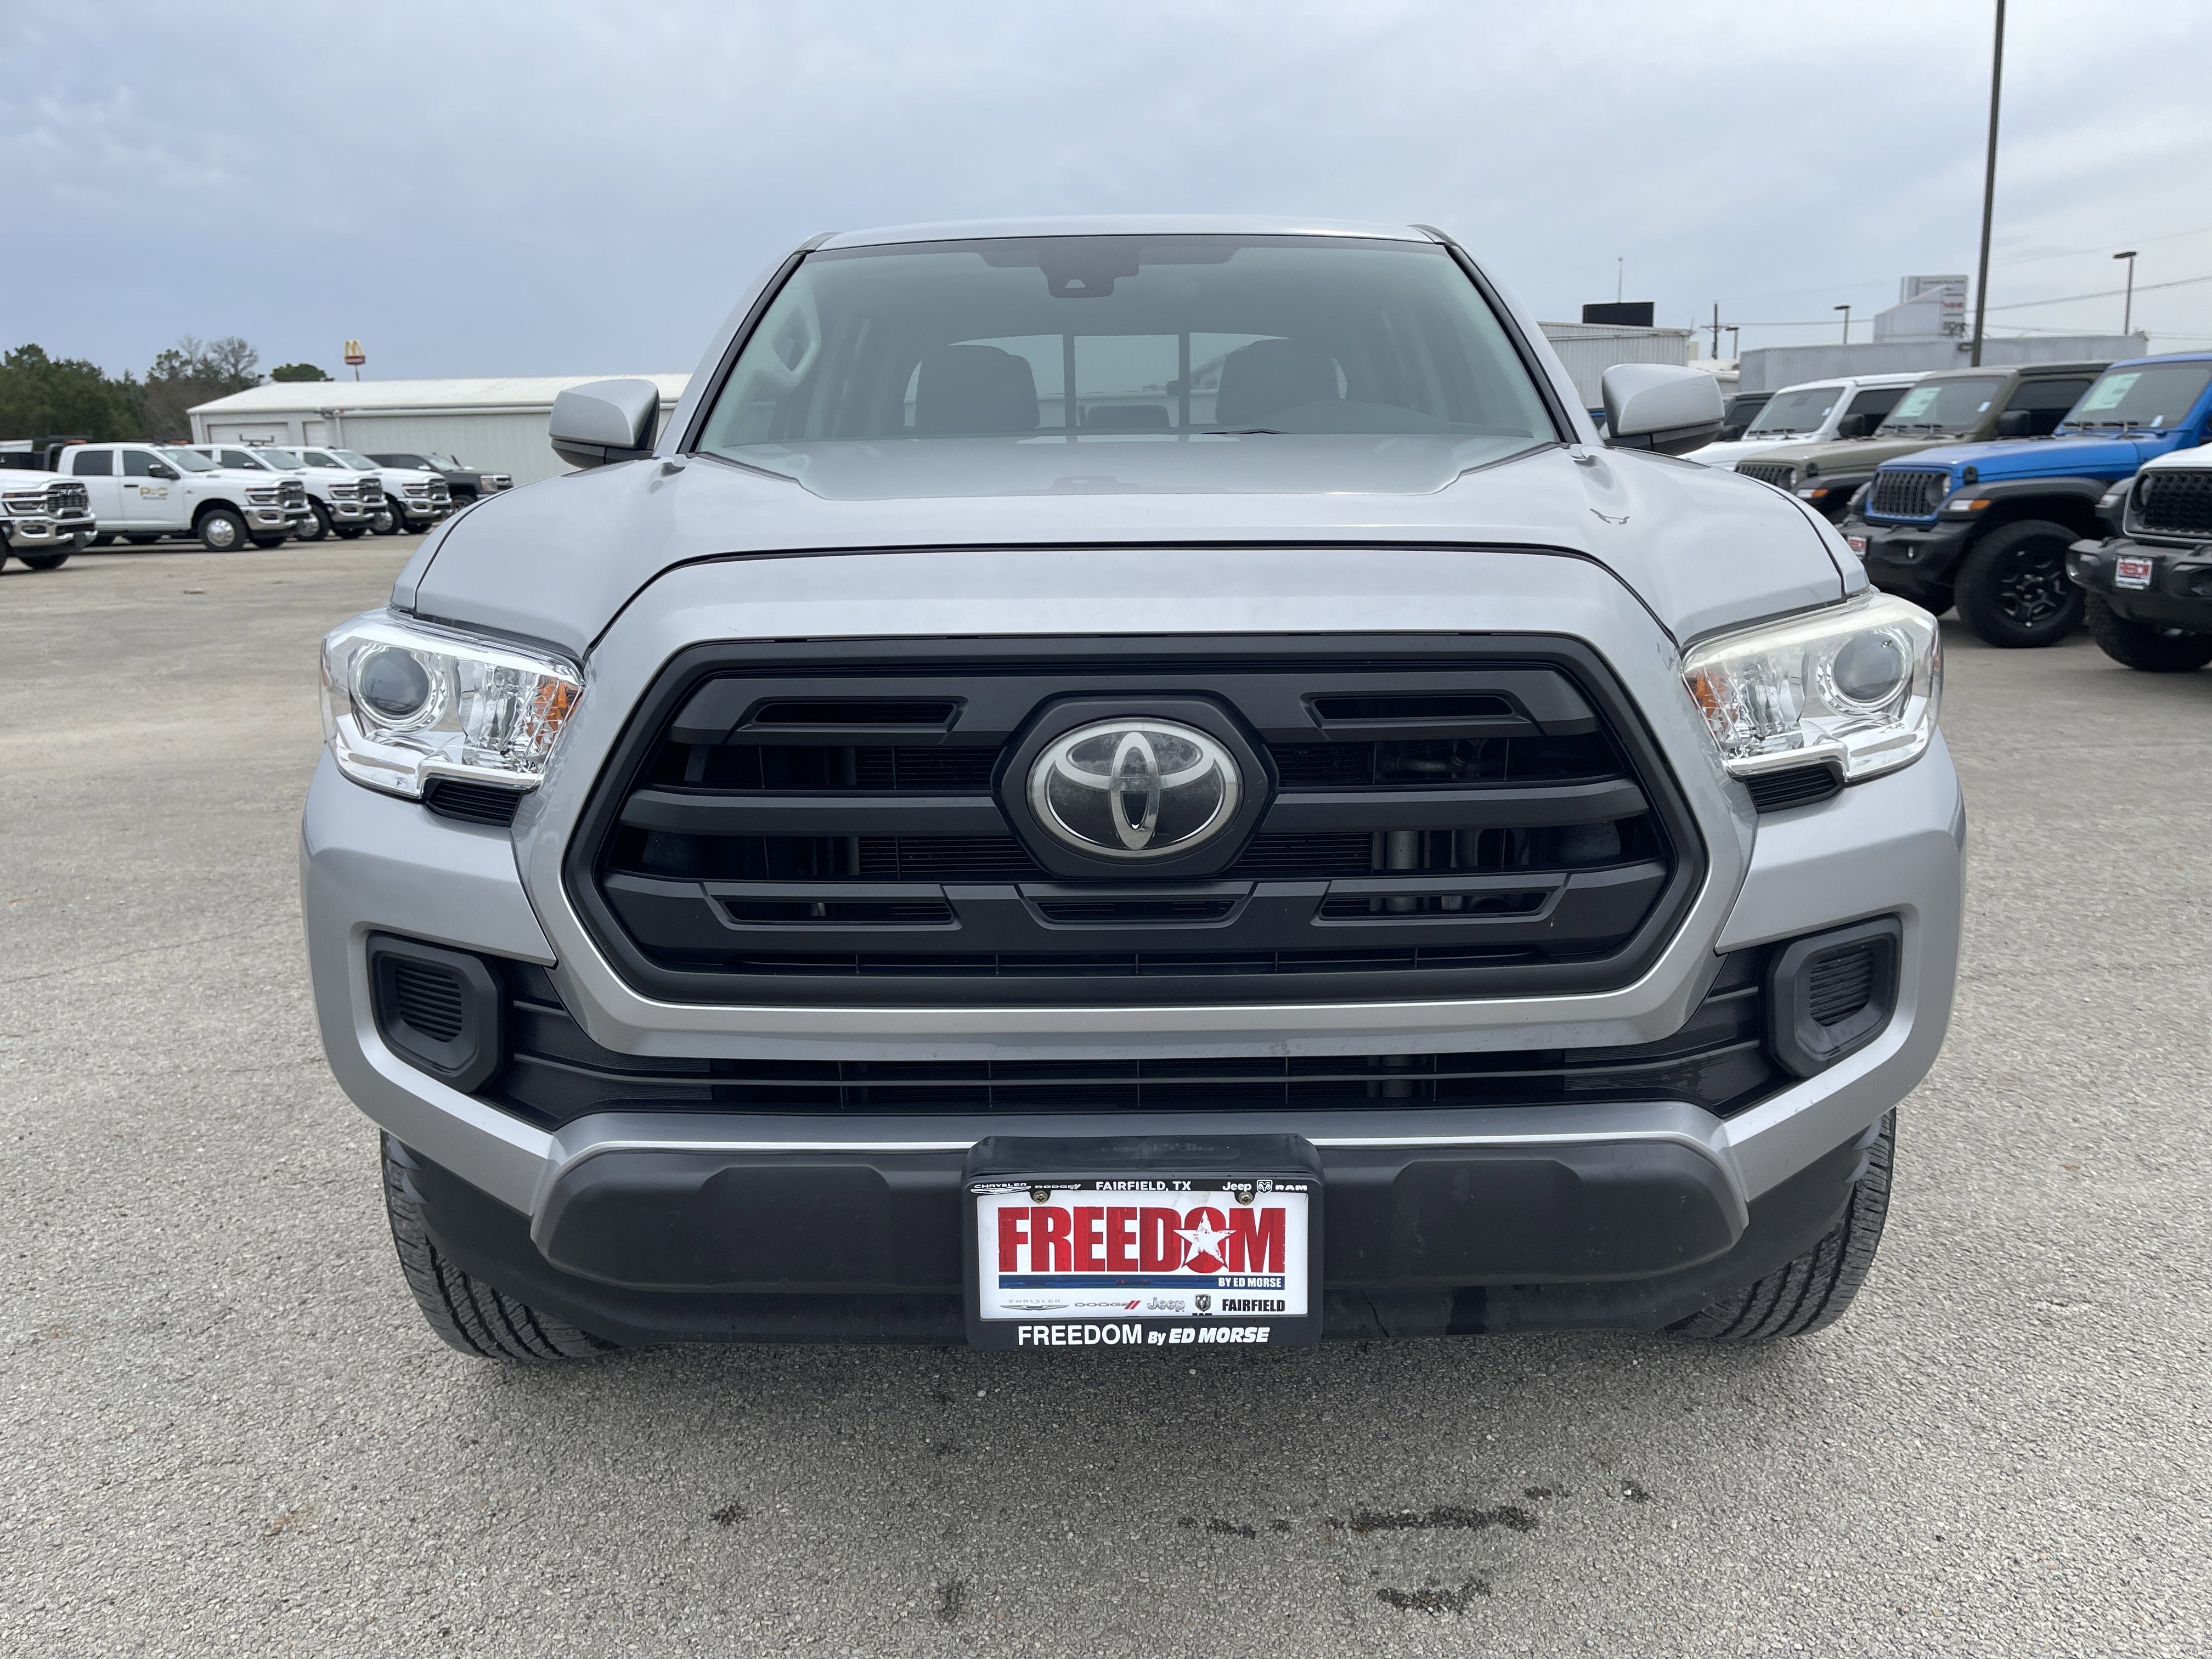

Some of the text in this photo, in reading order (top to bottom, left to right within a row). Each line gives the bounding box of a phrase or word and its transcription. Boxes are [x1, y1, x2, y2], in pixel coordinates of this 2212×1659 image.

[1096, 1181, 1192, 1192] FAIRFIELD, TX
[1222, 1182, 1252, 1192] Jeep
[998, 1206, 1286, 1273] FREEDOM
[1218, 1277, 1282, 1288] BY ED MORSE
[1147, 1297, 1186, 1313] Jeep
[1222, 1299, 1285, 1312] FAIRFIELD
[1018, 1324, 1271, 1346] FREEDOM By ED MORSE
